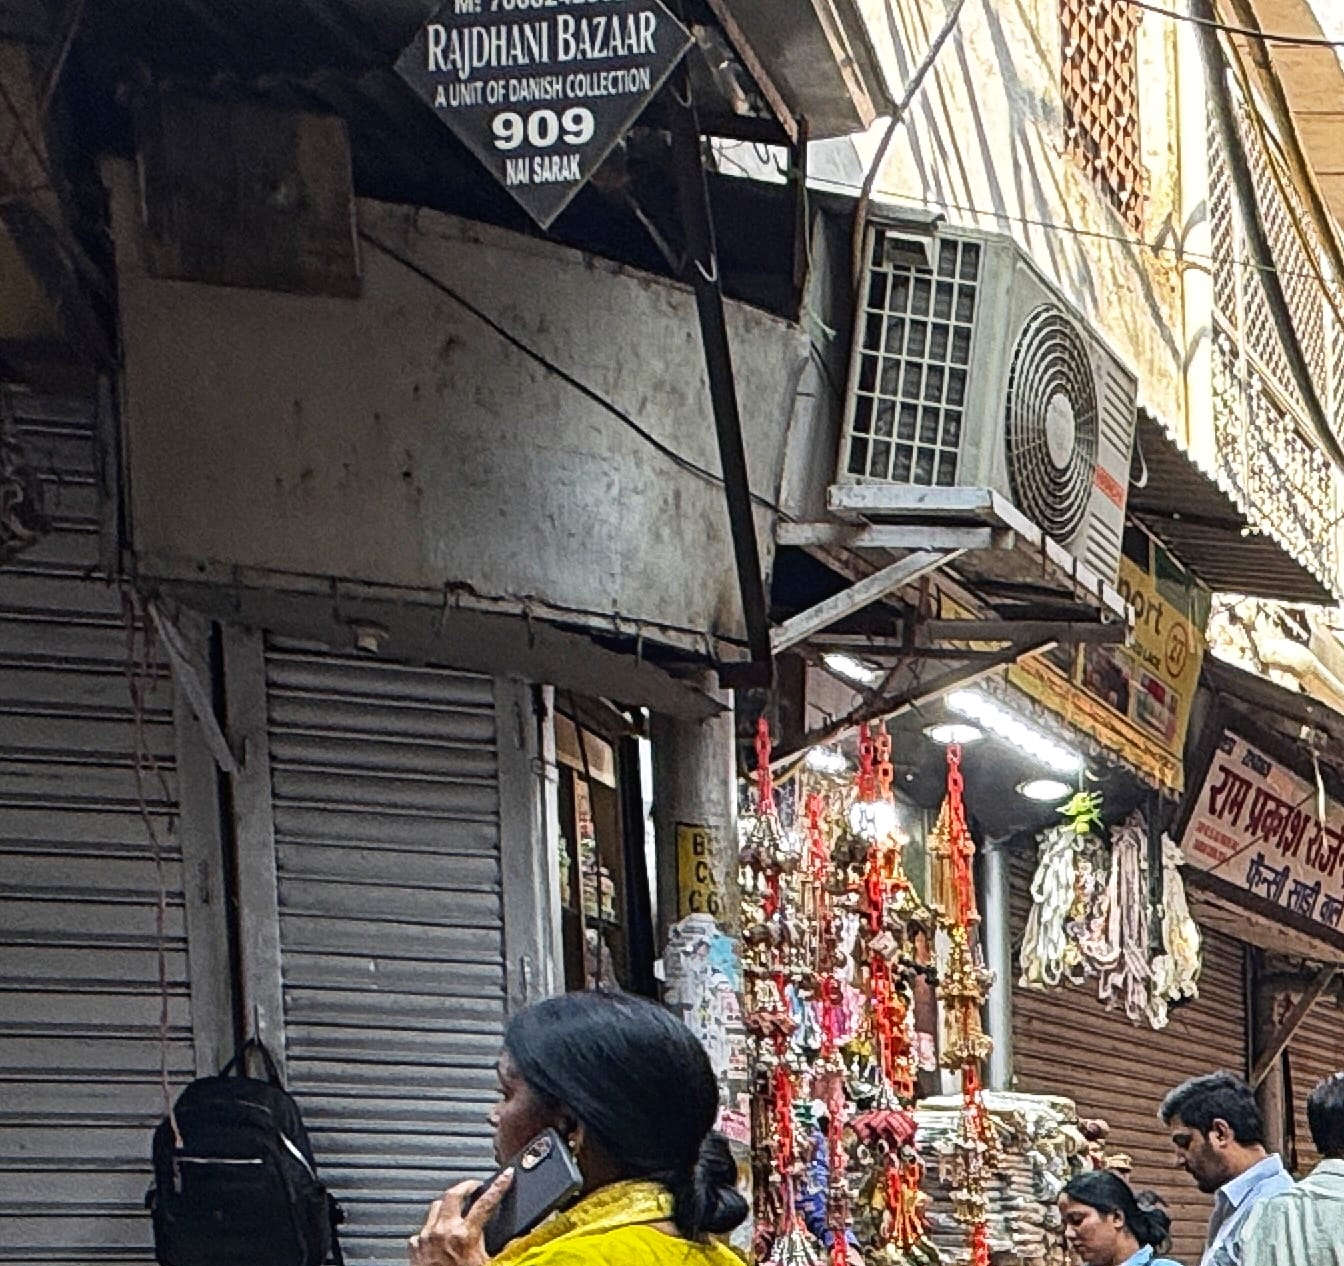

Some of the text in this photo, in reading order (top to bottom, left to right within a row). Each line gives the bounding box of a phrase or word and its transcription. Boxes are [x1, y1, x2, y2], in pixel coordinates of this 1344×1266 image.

[427, 11, 656, 80] RAJDHANI BAZAAR
[434, 67, 650, 108] A UNIT OF DANISH COLLECTION
[491, 107, 595, 150] 909
[505, 154, 581, 186] NAI SARAK
[1208, 764, 1253, 828] राम
[1243, 786, 1312, 858] प्रकाश
